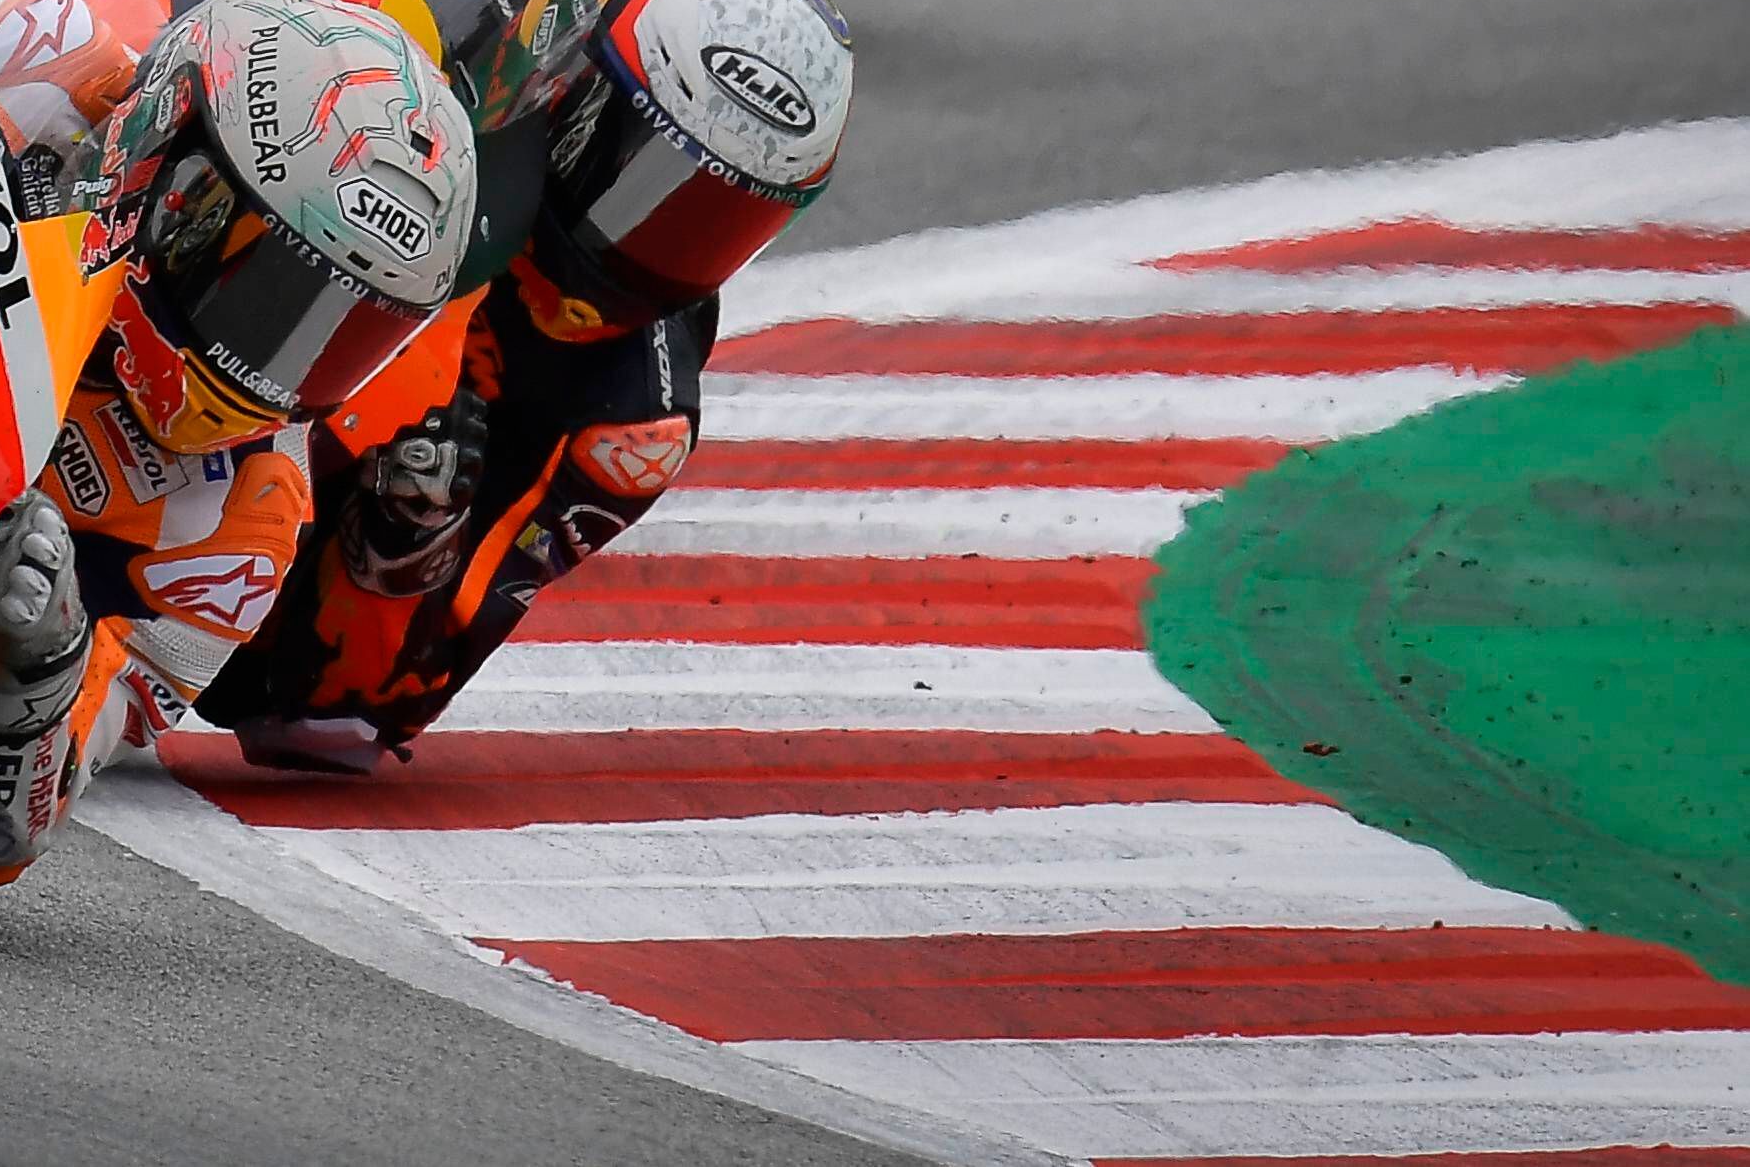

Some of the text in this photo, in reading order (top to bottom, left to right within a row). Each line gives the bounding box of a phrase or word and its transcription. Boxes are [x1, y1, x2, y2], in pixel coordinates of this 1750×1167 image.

[245, 25, 288, 186] PULL&BEAR
[714, 55, 807, 123] HJC
[632, 89, 689, 151] GIVES
[697, 150, 740, 187] YOU
[72, 175, 114, 198] Puig
[349, 188, 427, 255] SHOEI
[261, 213, 323, 268] GIVES
[328, 265, 370, 300] YOU
[205, 341, 301, 411] PULL&BEAR
[57, 425, 103, 506] SHOEI
